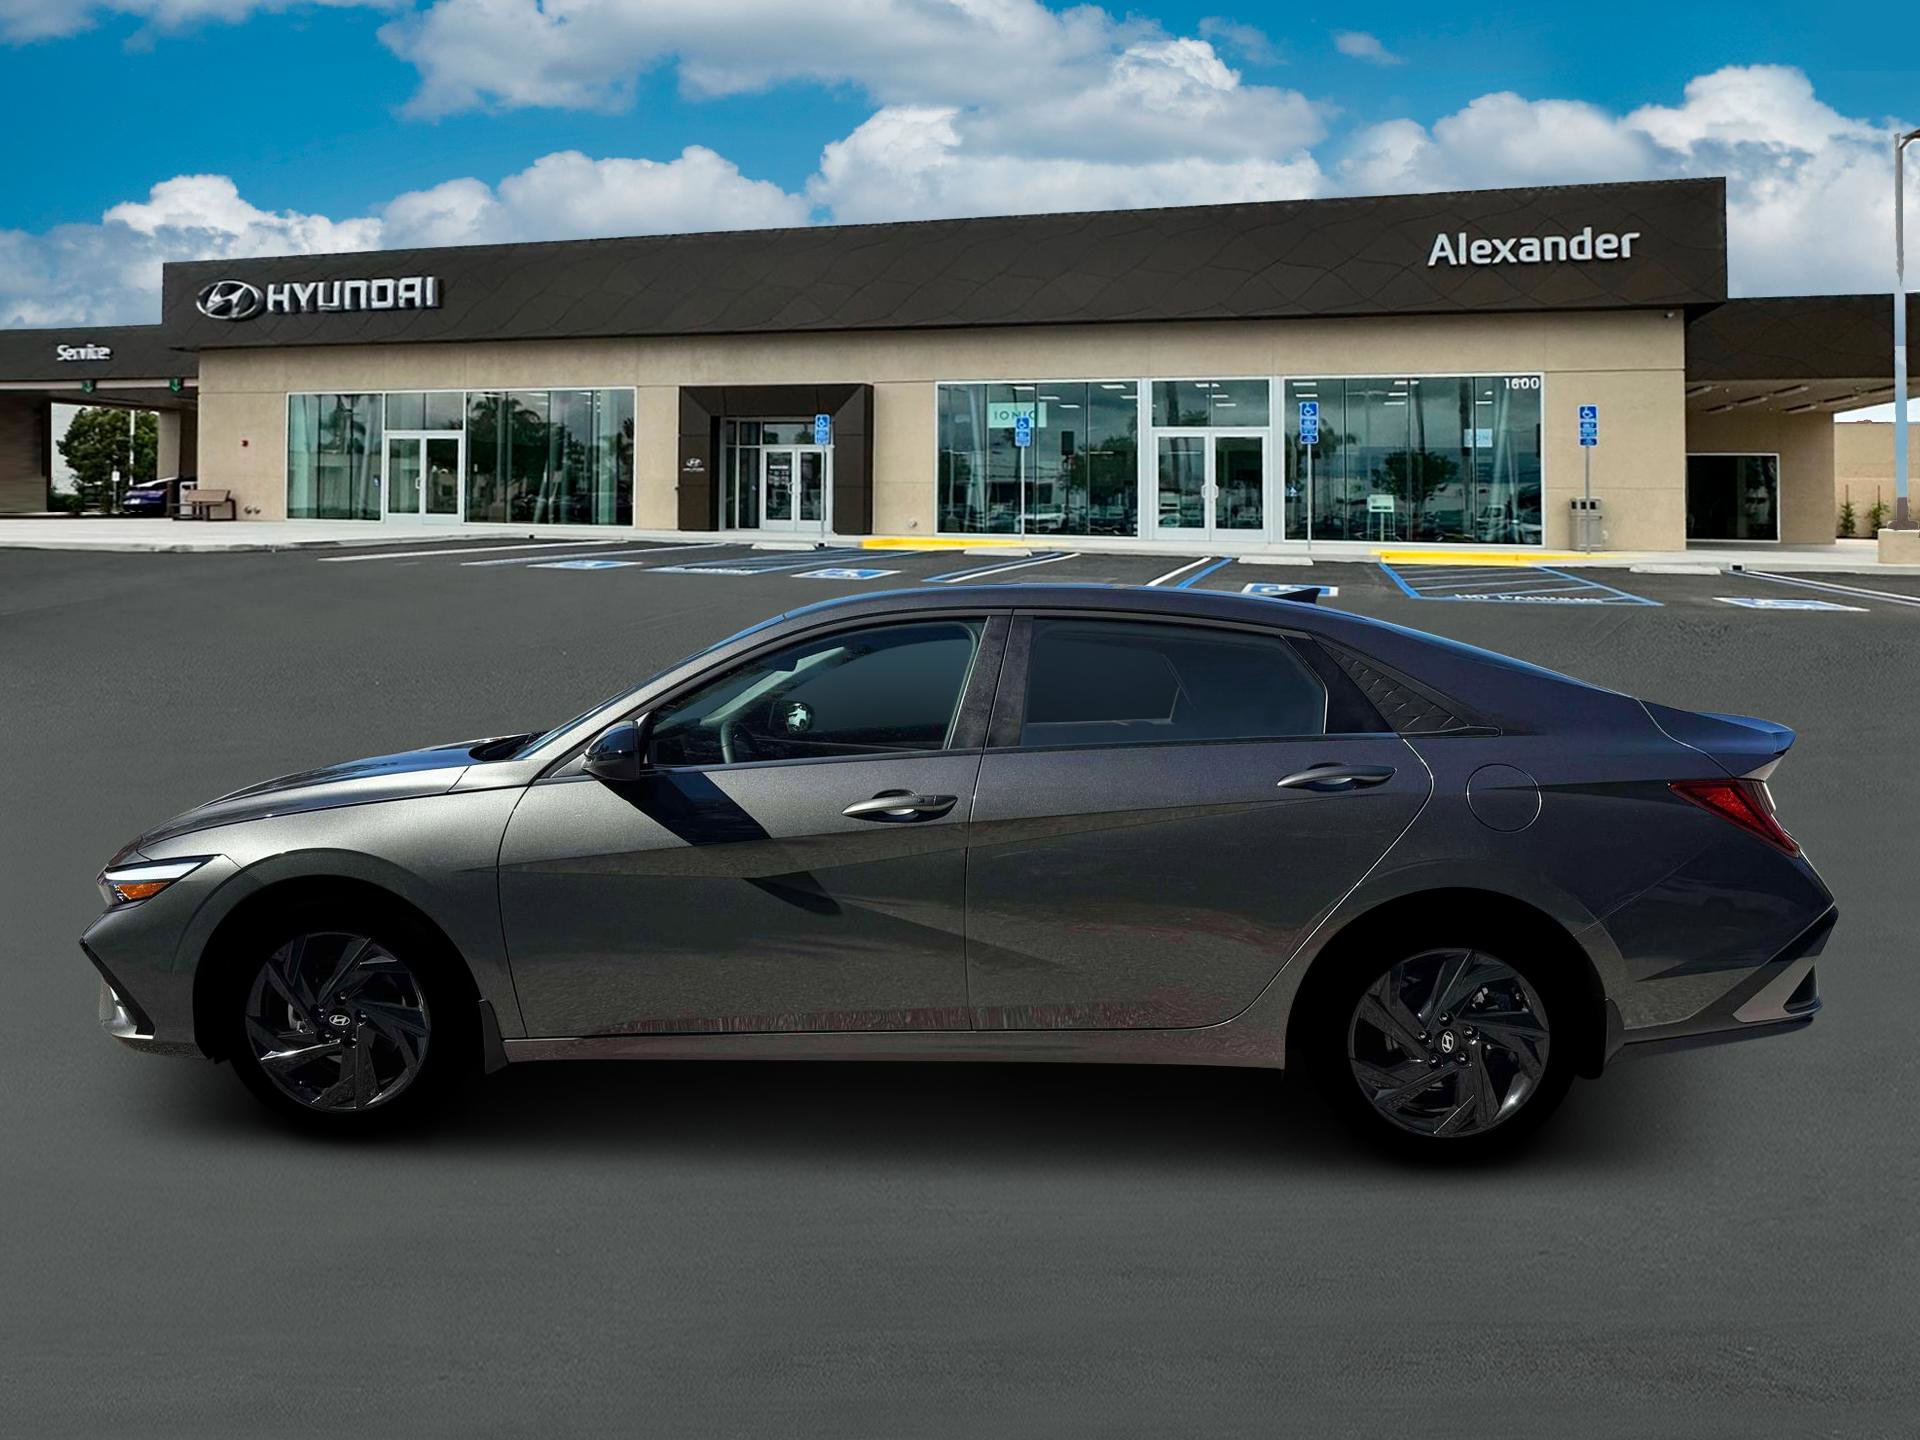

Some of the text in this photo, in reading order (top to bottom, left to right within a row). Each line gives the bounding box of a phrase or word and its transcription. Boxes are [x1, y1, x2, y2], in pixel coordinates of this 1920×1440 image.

[1427, 227, 1640, 266] Alexander
[267, 276, 438, 313] HYUNDAI
[56, 343, 111, 361] Service
[1504, 377, 1540, 390] 1600
